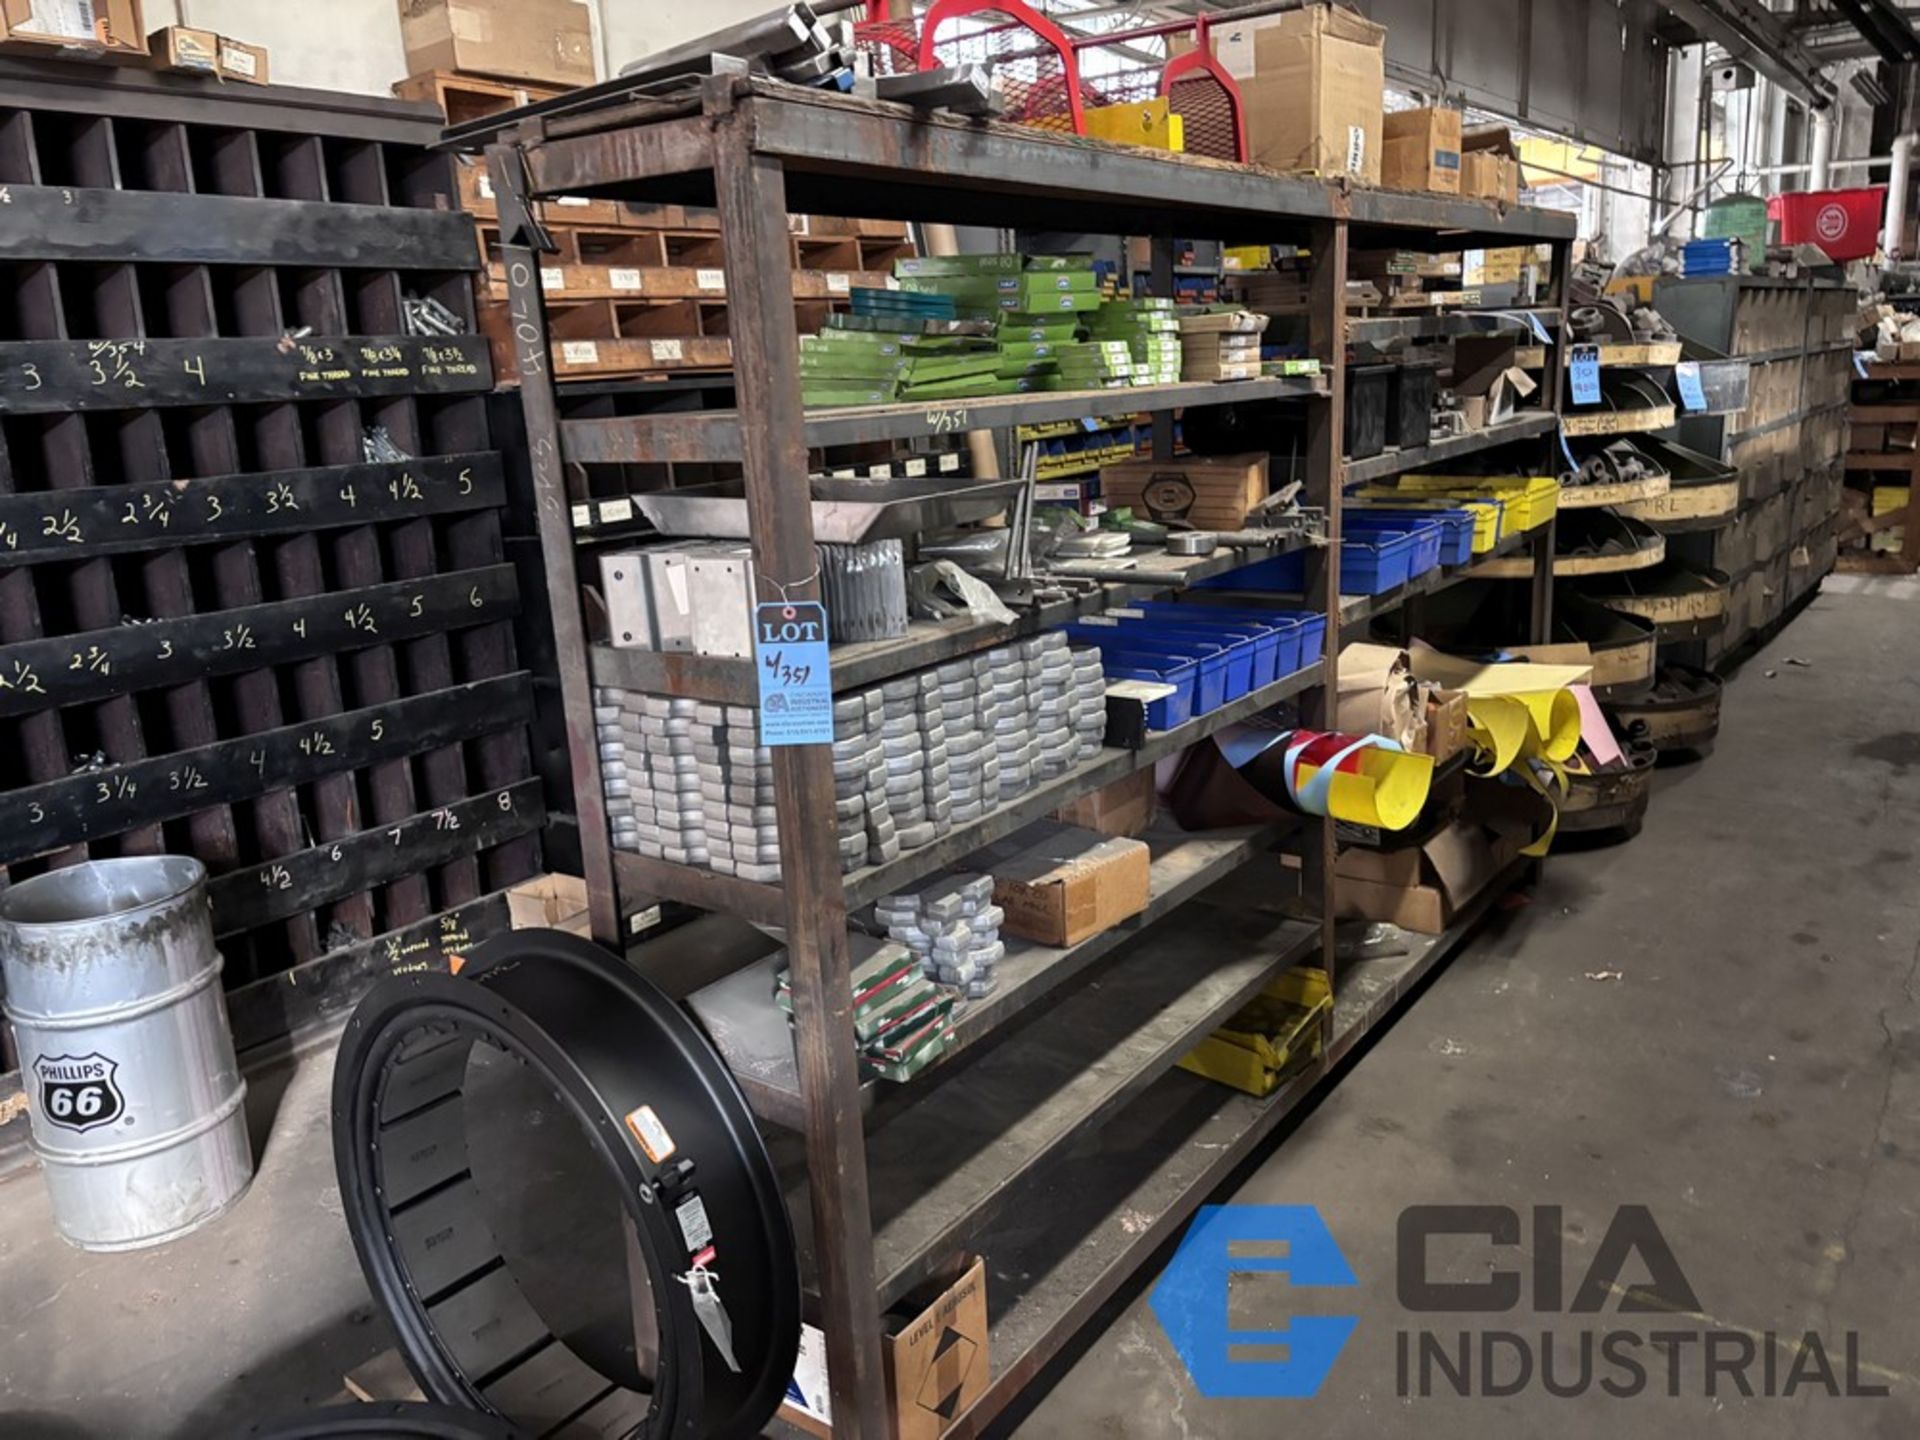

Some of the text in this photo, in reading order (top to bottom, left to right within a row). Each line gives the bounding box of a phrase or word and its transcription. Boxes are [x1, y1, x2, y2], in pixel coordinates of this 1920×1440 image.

[62, 190, 73, 204] 3
[21, 363, 42, 390] 3
[184, 355, 206, 386] 4
[459, 468, 473, 494] 5
[340, 485, 356, 507] 4
[207, 496, 222, 521] 3
[410, 595, 424, 617] 5
[470, 586, 483, 607] 6
[293, 618, 306, 638] 4
[763, 622, 819, 642] LOT
[157, 640, 173, 659] 3
[370, 719, 383, 741] 5
[250, 750, 266, 776] 4
[28, 801, 44, 823] 3
[498, 791, 511, 811] 8
[388, 828, 401, 845] 7
[331, 847, 342, 861] 6
[40, 1063, 105, 1080] PHILLIPS
[51, 1086, 104, 1117] 66
[909, 1319, 935, 1347] LEVEL
